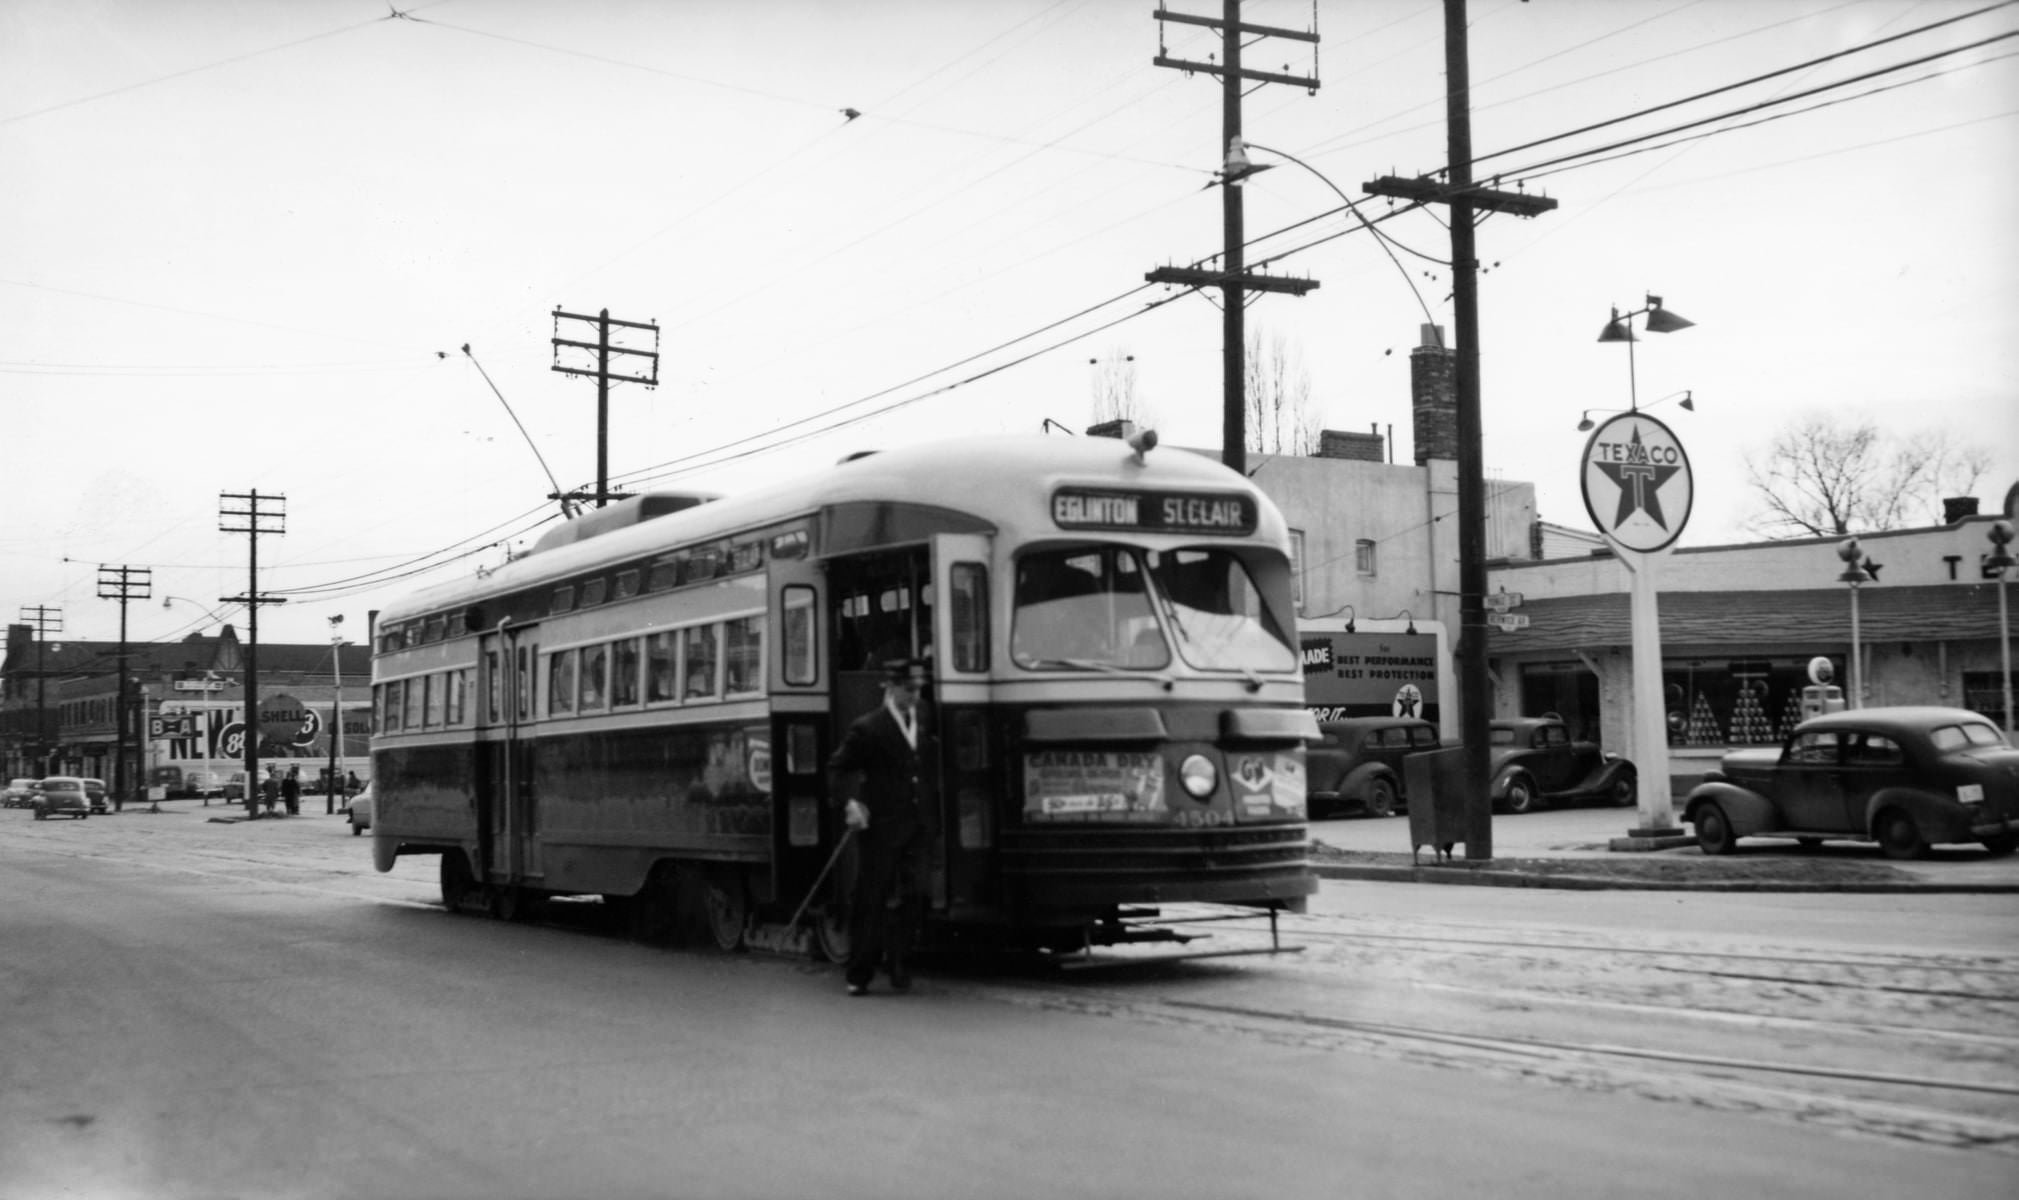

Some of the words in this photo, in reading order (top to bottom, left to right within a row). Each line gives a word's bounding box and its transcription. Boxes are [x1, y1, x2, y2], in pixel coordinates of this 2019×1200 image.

[1598, 442, 1678, 465] TEXACO
[1055, 496, 1138, 525] EGLINTON
[1942, 554, 2019, 580] TE
[1337, 655, 1360, 665] BEST
[1364, 655, 1434, 667] PERFORMANCE
[1337, 669, 1363, 679] BEST
[1369, 669, 1435, 680] PROTECTION
[262, 710, 306, 723] SHELL
[296, 713, 315, 735] 3
